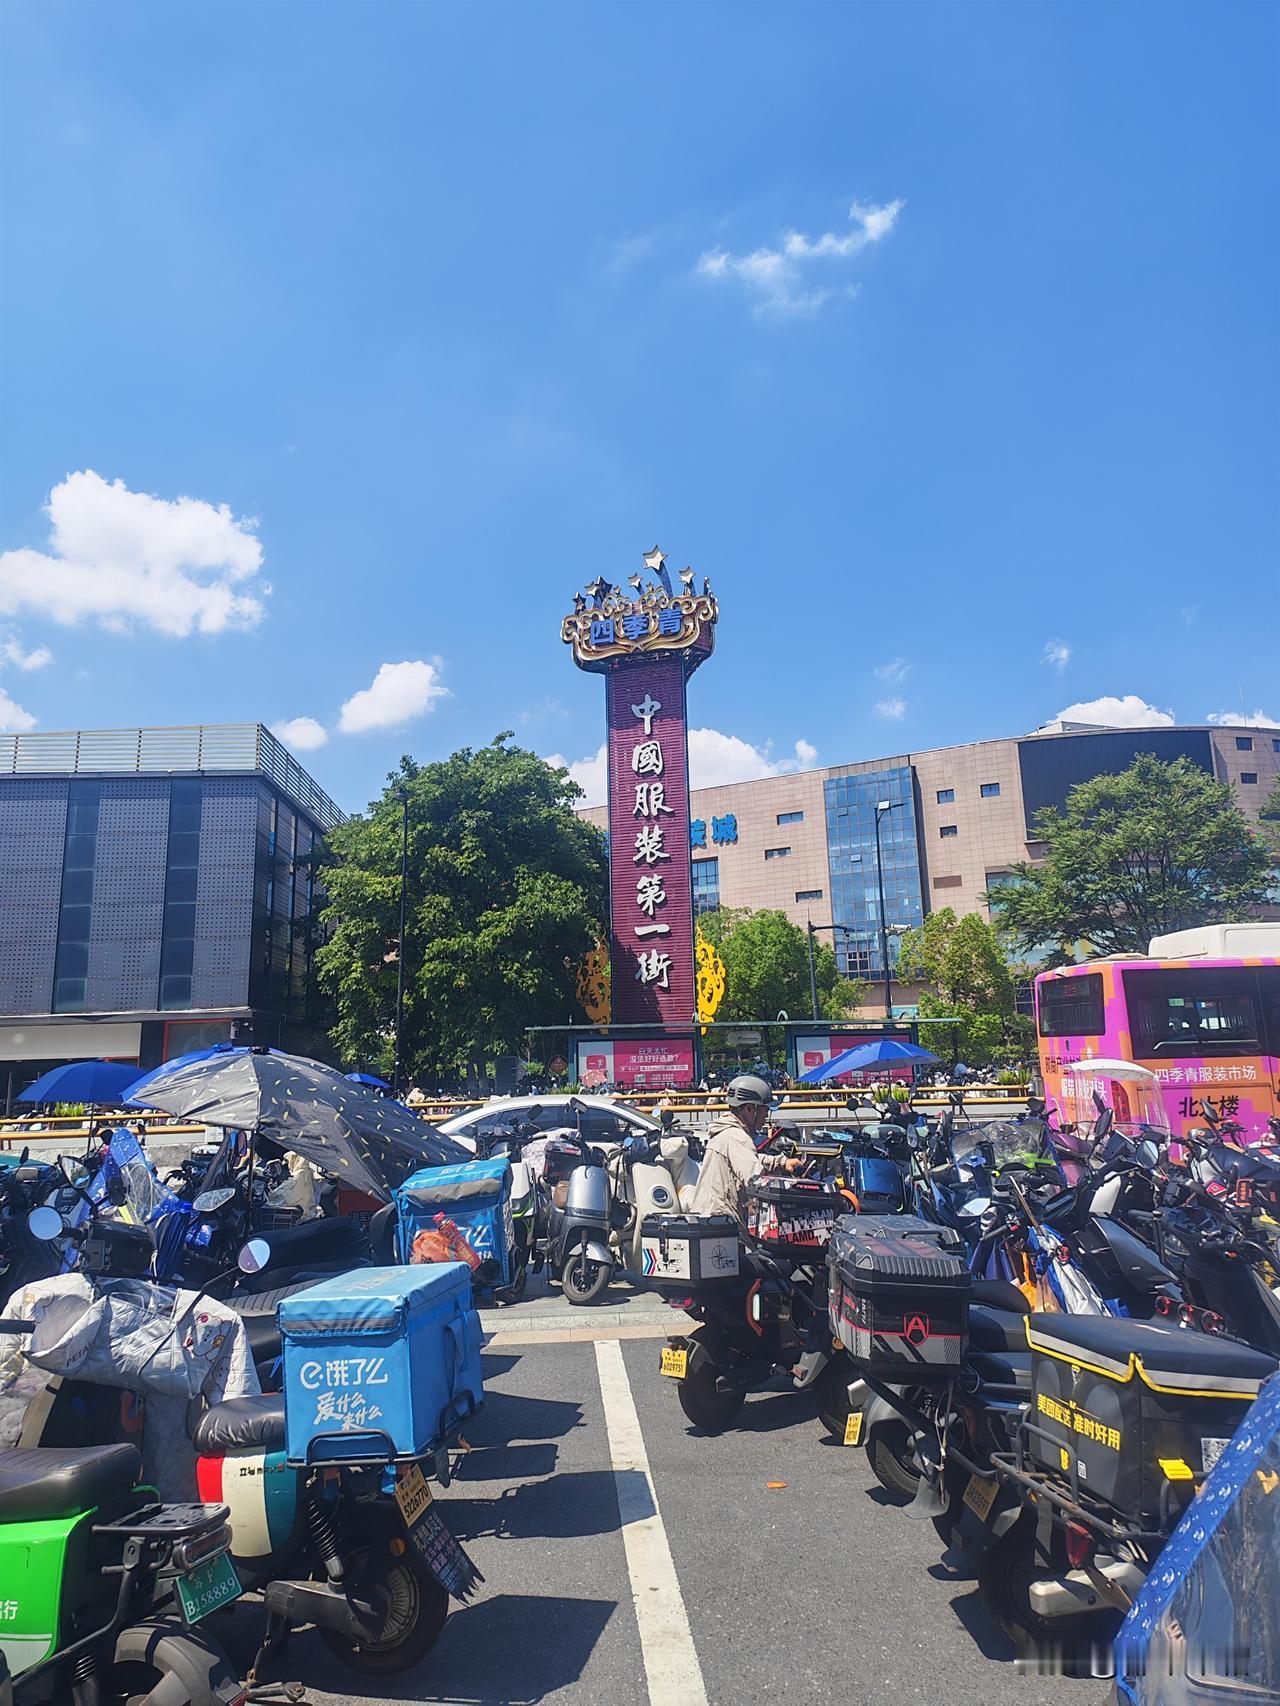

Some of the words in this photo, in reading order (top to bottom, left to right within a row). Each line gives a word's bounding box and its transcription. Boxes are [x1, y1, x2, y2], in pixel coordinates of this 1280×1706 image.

[590, 609, 684, 647] 四季青
[1155, 1065, 1257, 1083] 四季青服装市场
[325, 1358, 389, 1387] 饿了么
[1037, 1393, 1073, 1429] 美团配送
[1073, 1412, 1121, 1451] 准时好用
[403, 1485, 429, 1519] 5226770
[0, 1599, 18, 1620] 行
[186, 1576, 236, 1616] B158889
